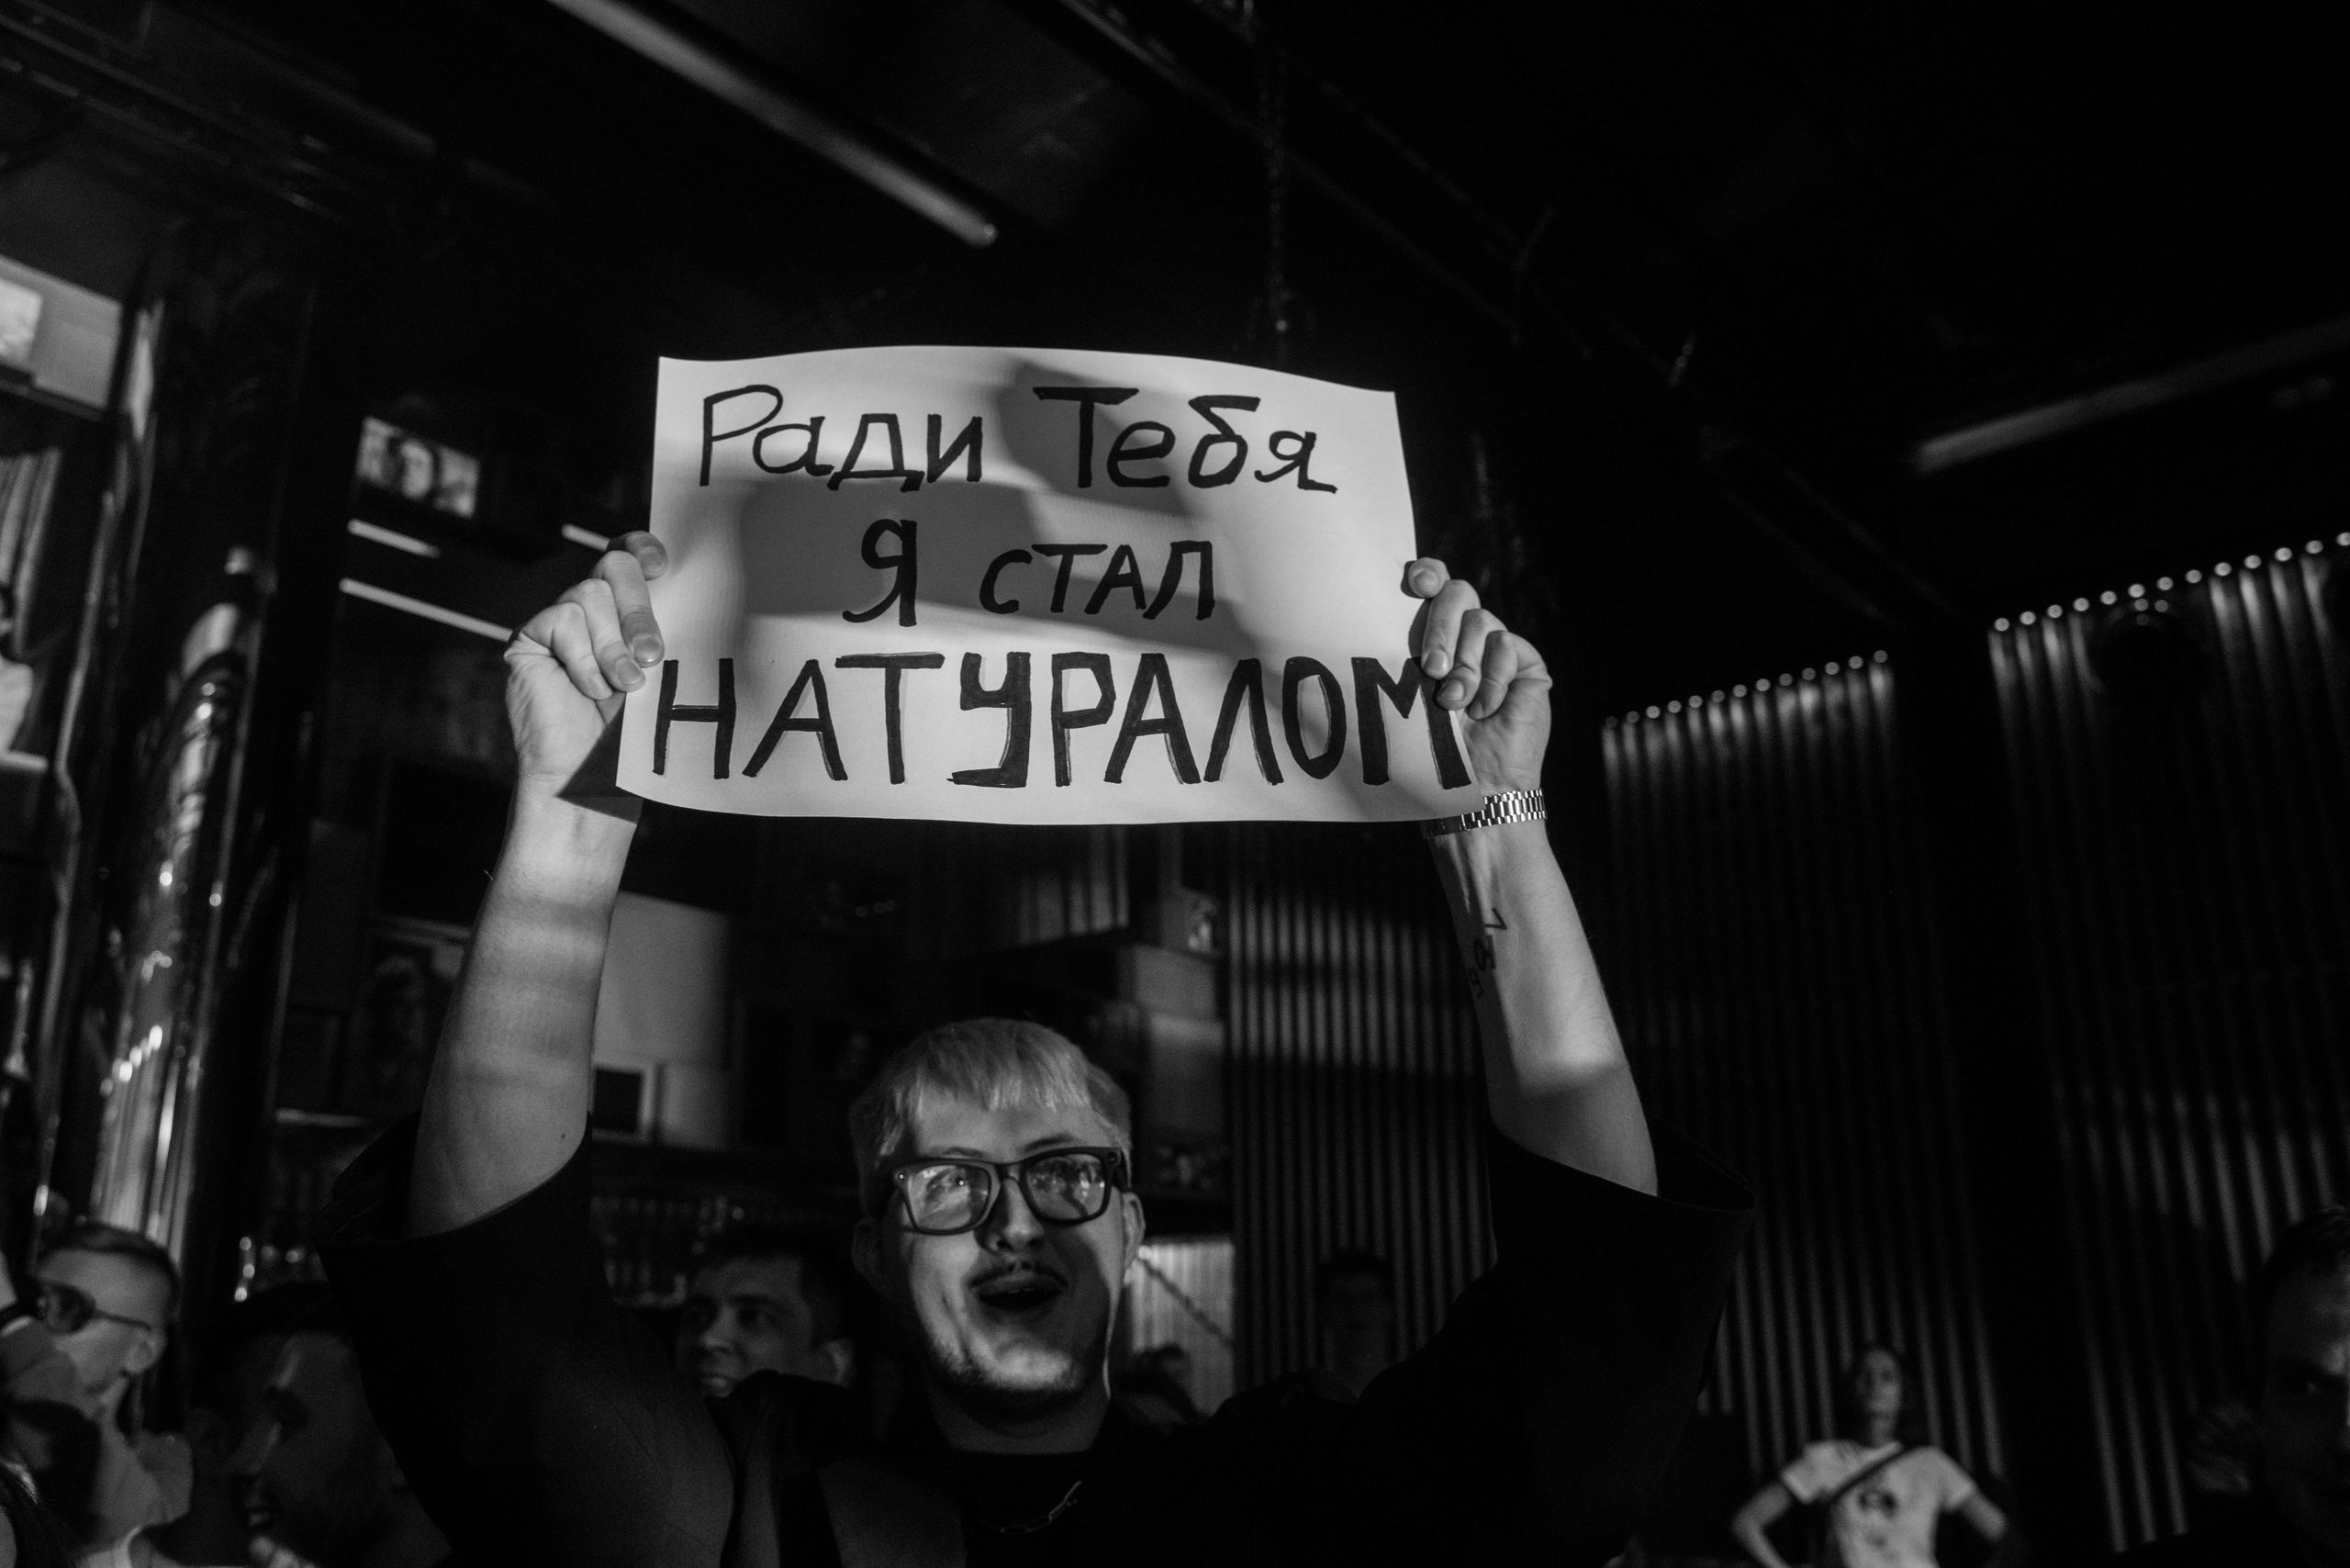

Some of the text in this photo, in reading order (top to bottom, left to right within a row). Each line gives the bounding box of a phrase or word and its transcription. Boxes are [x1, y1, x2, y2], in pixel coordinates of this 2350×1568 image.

[699, 384, 1337, 494] Ради Тебя
[843, 519, 918, 626] Я
[653, 651, 1472, 790] НАТУРАЛОМ
